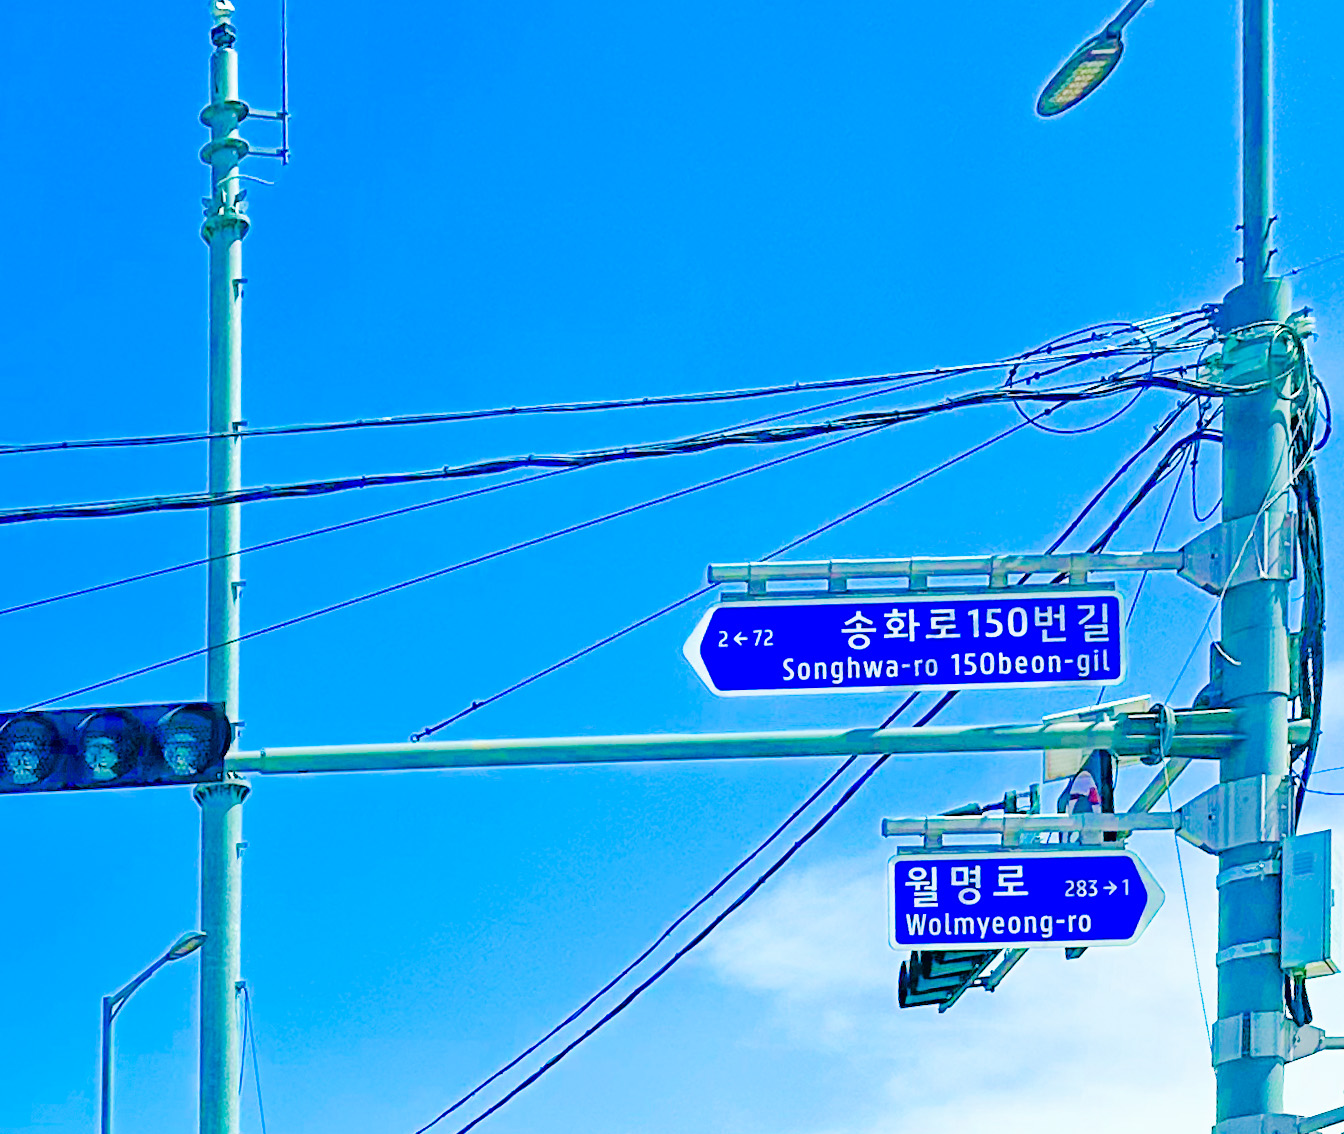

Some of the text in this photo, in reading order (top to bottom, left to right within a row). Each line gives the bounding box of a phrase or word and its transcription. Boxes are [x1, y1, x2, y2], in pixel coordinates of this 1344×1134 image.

[718, 629, 774, 648] 2 72
[841, 604, 1110, 650] 송화로150번길
[782, 648, 1110, 684] Songhwa-ro 150beon-gil
[905, 865, 1029, 908] 월명로
[1065, 879, 1130, 898] 283 1
[906, 912, 1092, 939] Wolmyeong-ro
